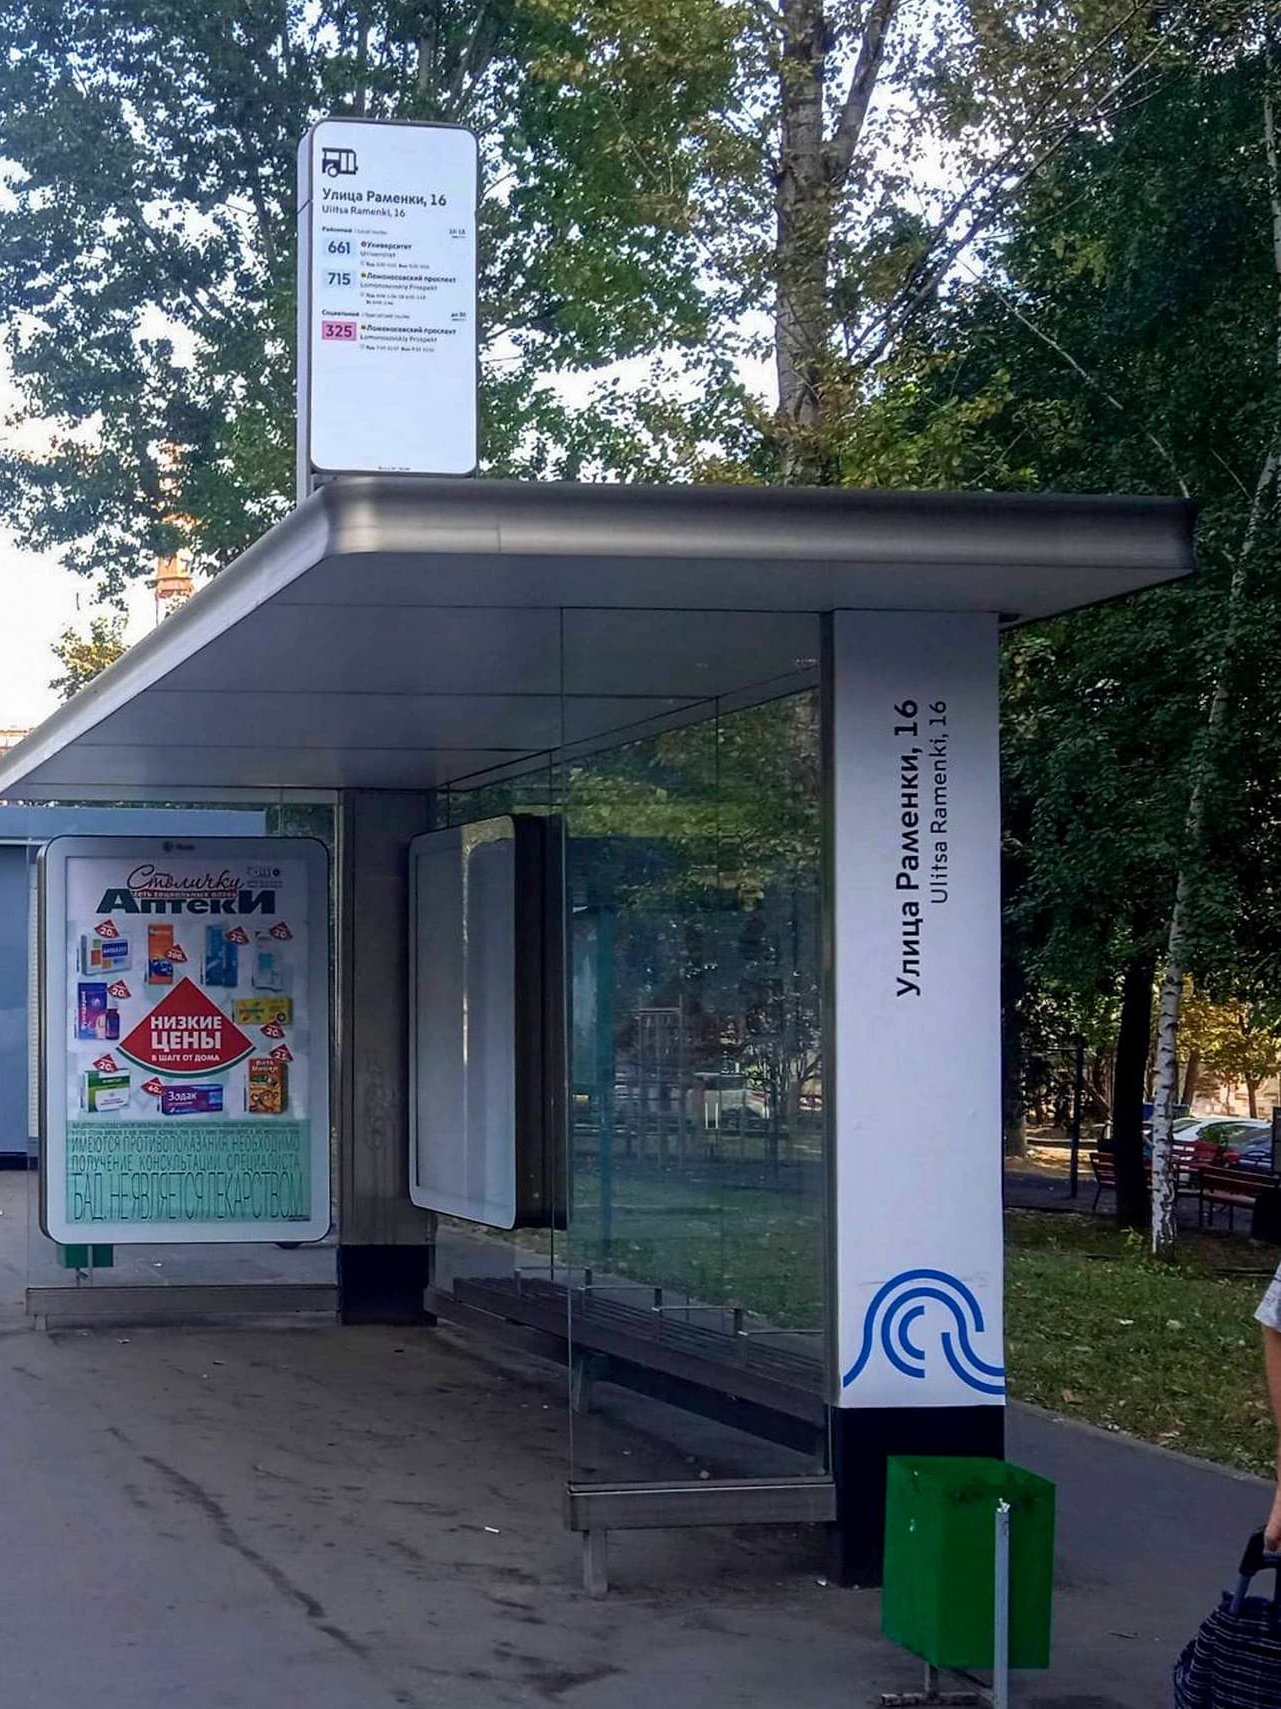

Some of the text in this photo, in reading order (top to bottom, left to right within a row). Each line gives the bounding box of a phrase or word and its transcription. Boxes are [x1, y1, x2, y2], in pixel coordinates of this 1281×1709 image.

[322, 188, 447, 207] Улица Раменки, 16
[395, 208, 406, 218] 16
[327, 241, 351, 255] 661
[327, 272, 351, 286] 715
[325, 324, 353, 338] 325
[929, 700, 949, 905] Ulitsa Ramenki, 16
[894, 699, 924, 997] Улица Раменки, 16
[126, 863, 245, 890] Столички
[150, 1016, 222, 1030] НИЗКИЕ
[151, 1031, 222, 1052] ЦЕНЫ
[151, 1054, 220, 1063] В ШАГЕ ОТ ДОМА
[71, 1135, 120, 1153] ИМЕЮТСЯ
[71, 1154, 133, 1172] ПОЛУЧЕНИЕ
[139, 1154, 219, 1172] КОНСУЛЬТАЦИИ
[110, 1173, 129, 1220] НЕ
[131, 1172, 204, 1220] ЯВЛЯЕТСЯ
